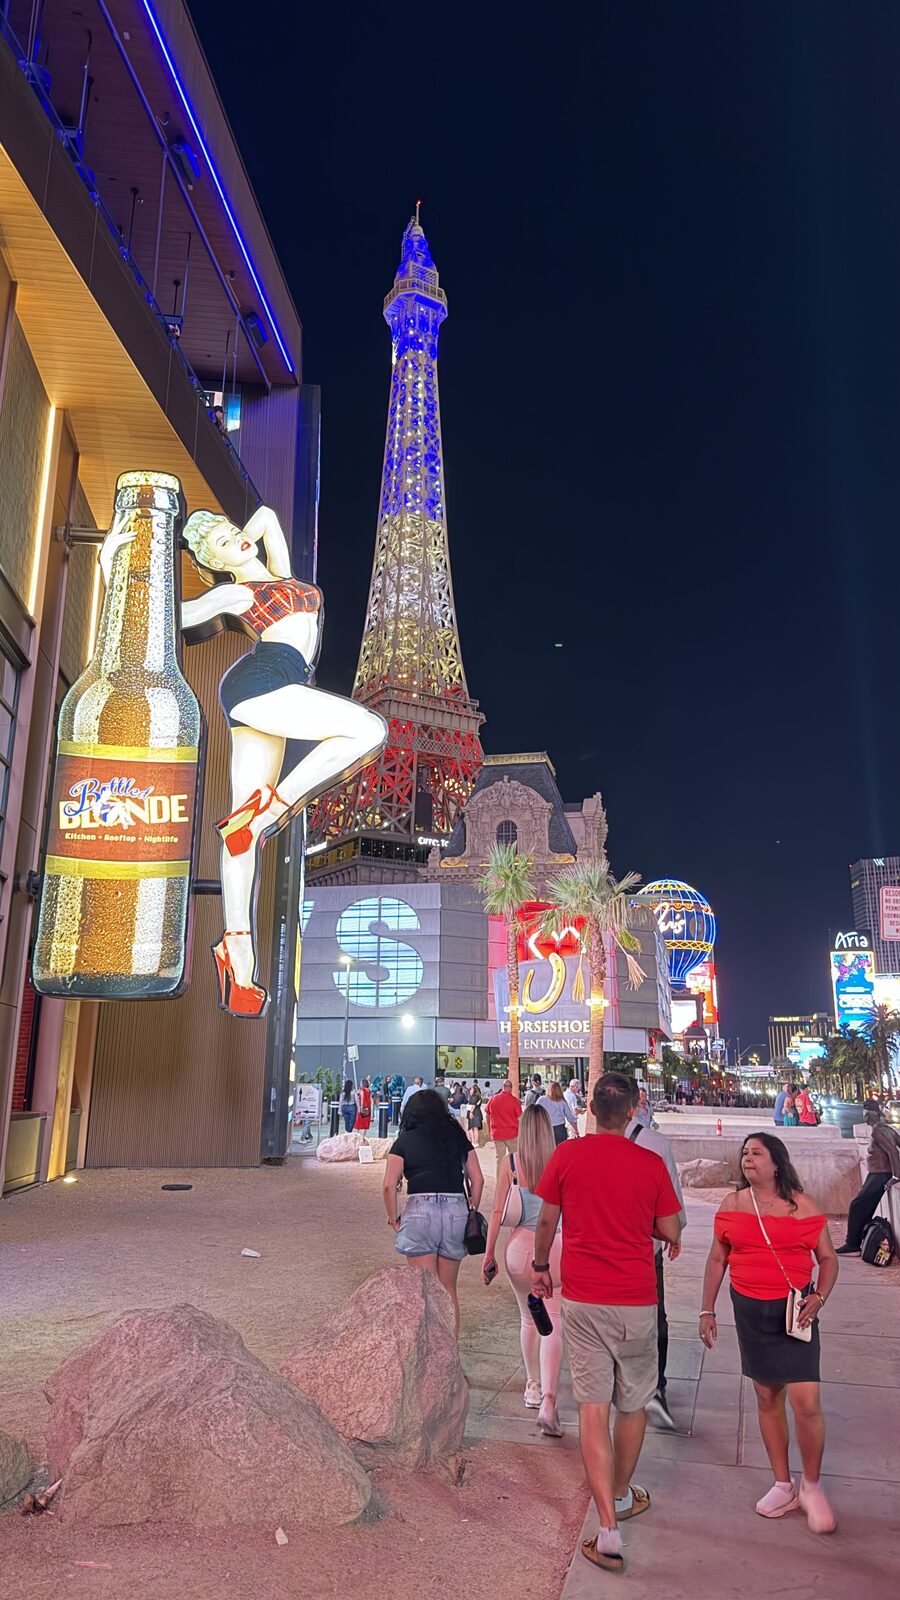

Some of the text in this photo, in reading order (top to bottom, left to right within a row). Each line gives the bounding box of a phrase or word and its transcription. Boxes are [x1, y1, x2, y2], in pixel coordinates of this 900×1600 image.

[64, 832, 179, 844] Kitchen Rooftop Nightlife
[835, 931, 869, 950] Aria
[303, 896, 424, 1008] S
[523, 1039, 585, 1050] ENTRANCE
